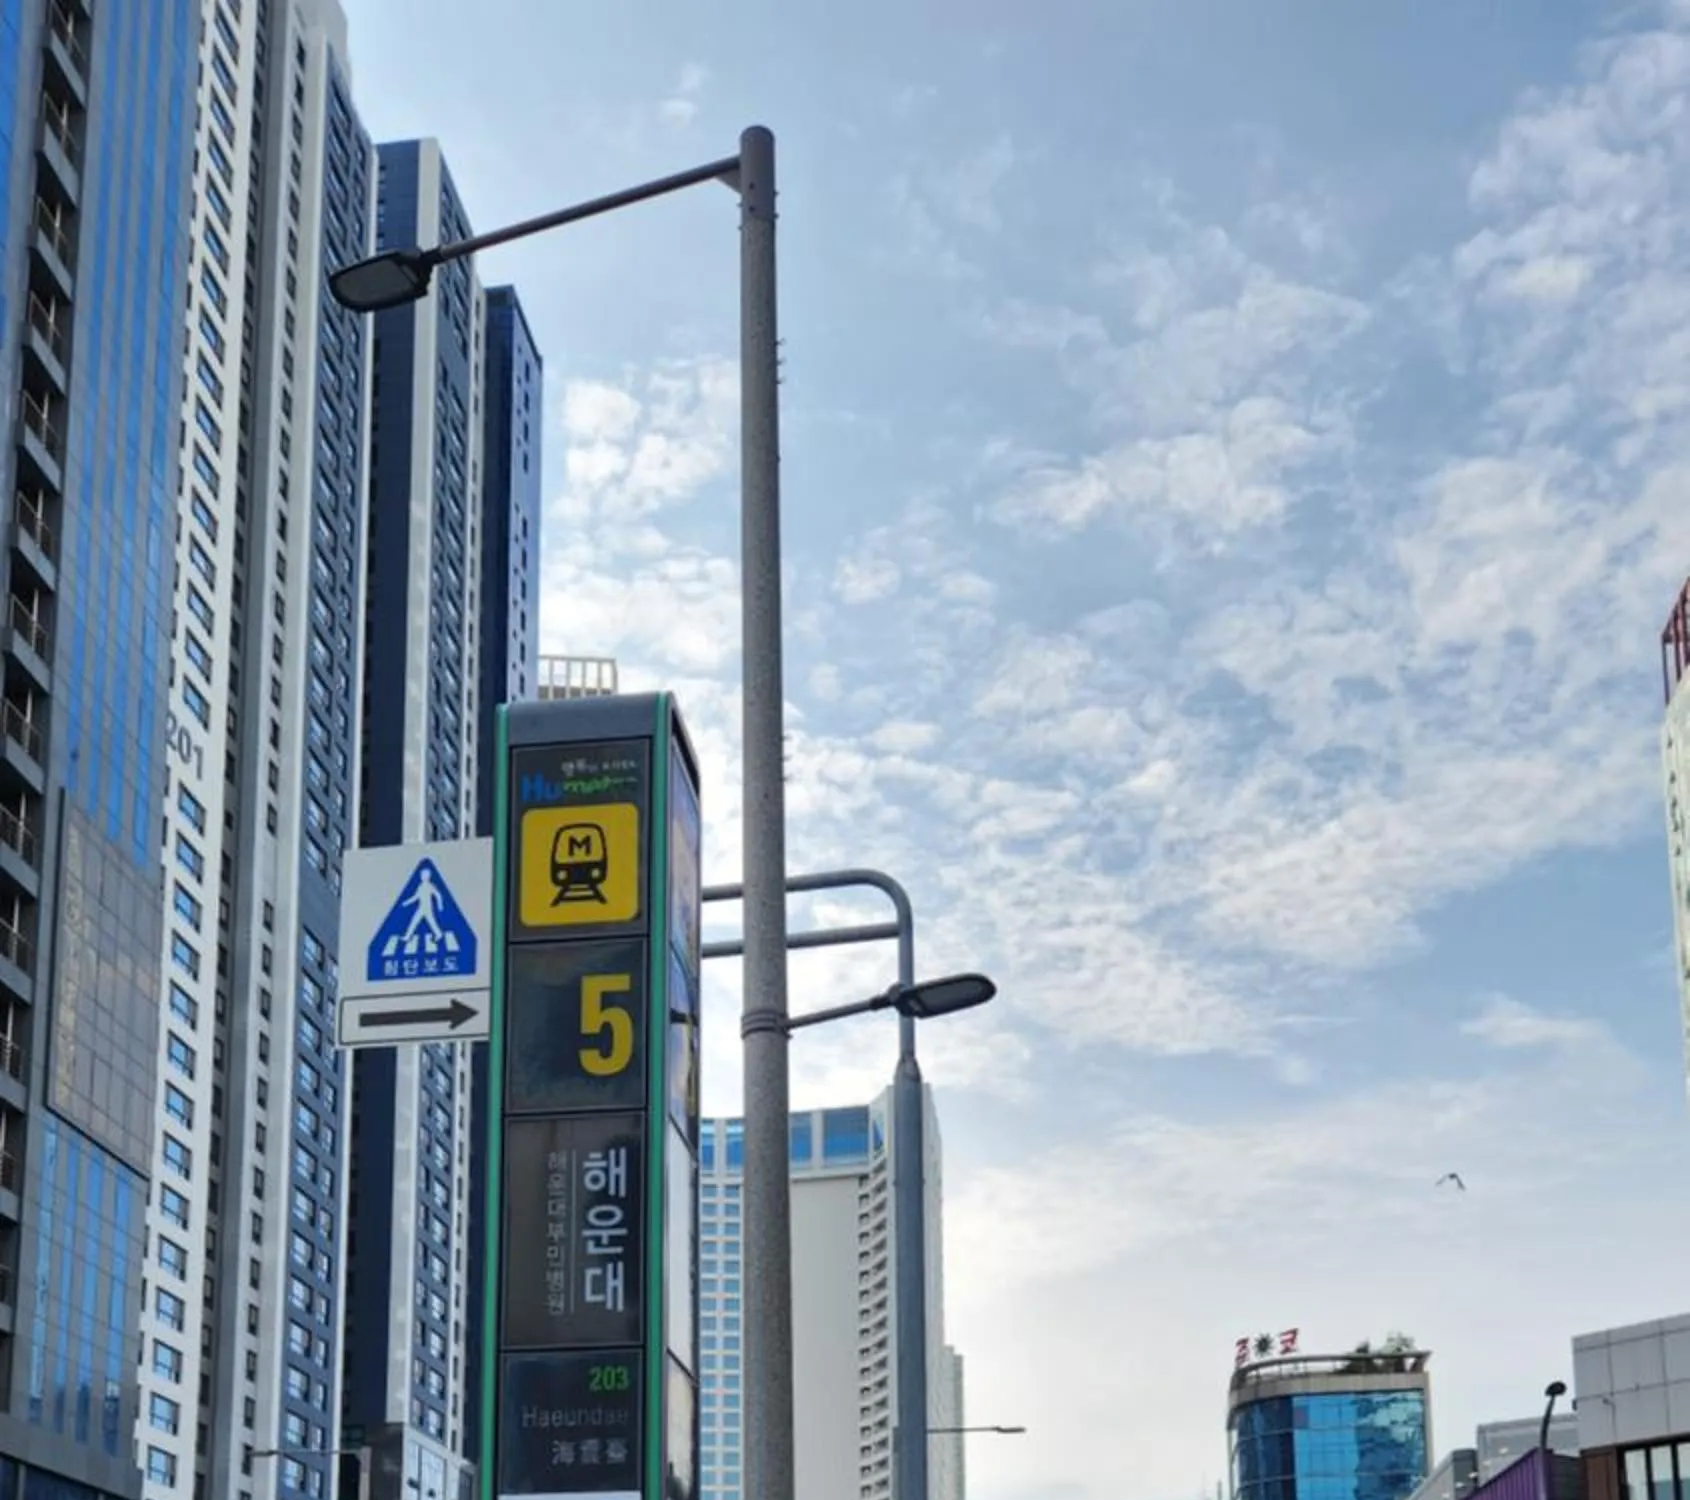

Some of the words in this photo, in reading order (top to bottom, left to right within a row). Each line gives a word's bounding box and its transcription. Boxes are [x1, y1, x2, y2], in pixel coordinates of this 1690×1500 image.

[165, 710, 204, 781] 201
[384, 957, 459, 977] 횡단보도
[579, 973, 634, 1077] 5
[582, 1147, 629, 1313] 해운대
[589, 1366, 629, 1391] 203
[522, 1404, 629, 1428] Haeundae
